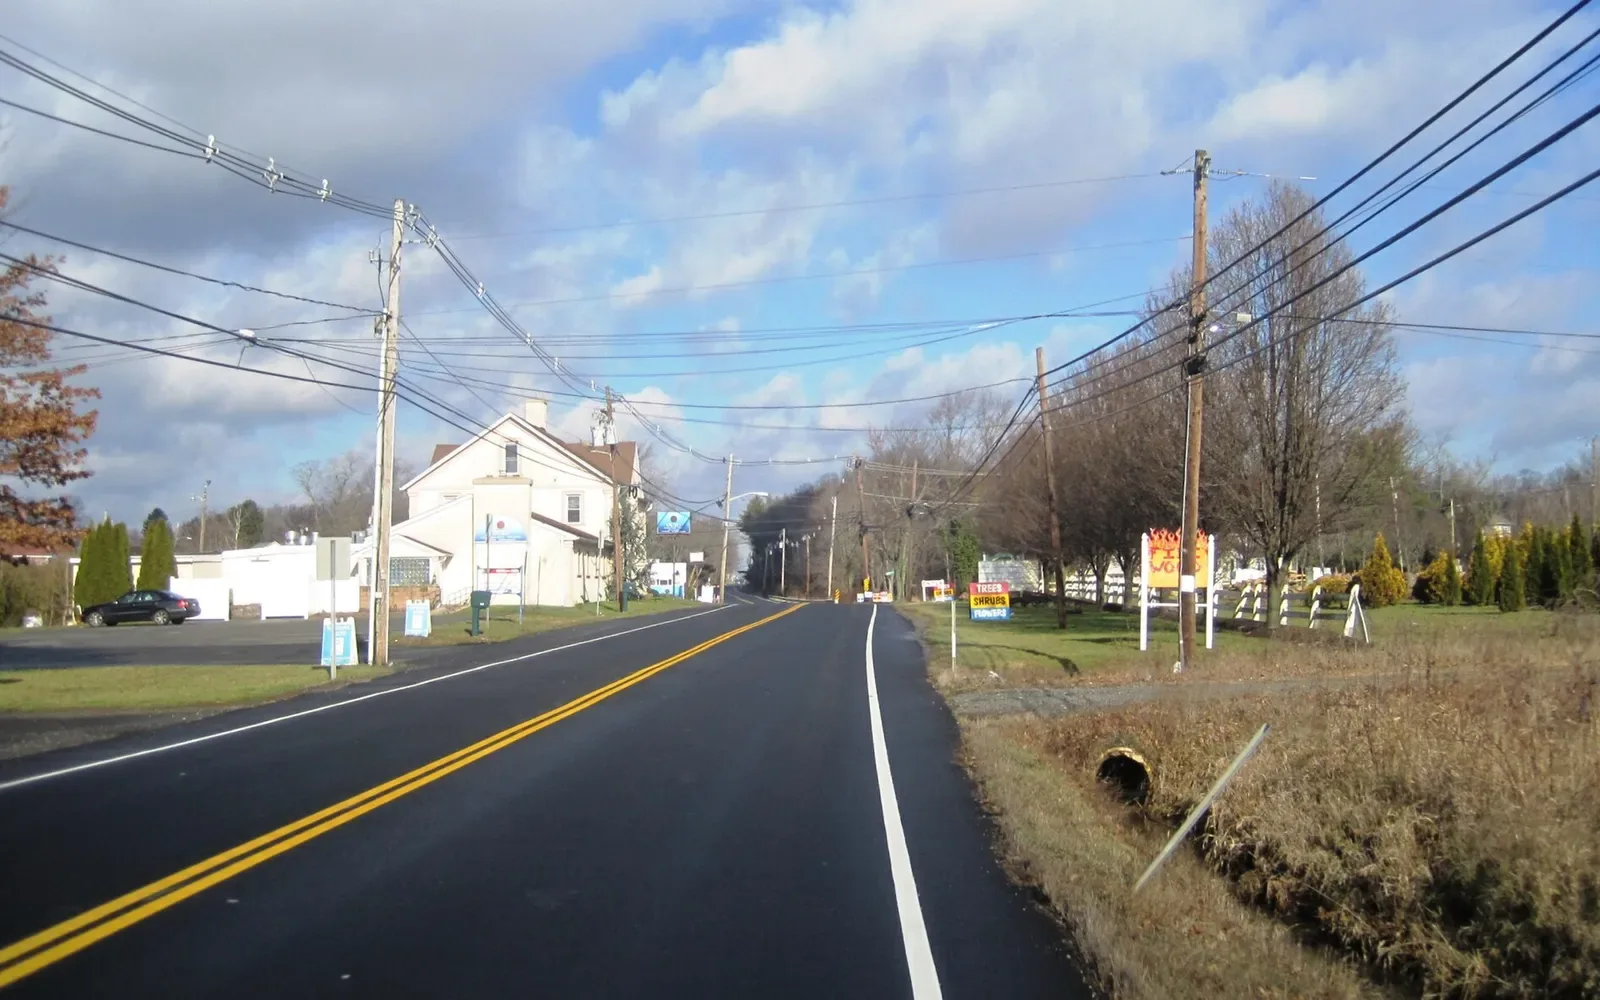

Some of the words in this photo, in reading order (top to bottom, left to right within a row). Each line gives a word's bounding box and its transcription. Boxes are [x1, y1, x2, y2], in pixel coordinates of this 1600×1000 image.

[977, 583, 1003, 593] TREES
[973, 596, 1006, 606] SHRUBS
[974, 608, 1007, 618] FLOWERS
